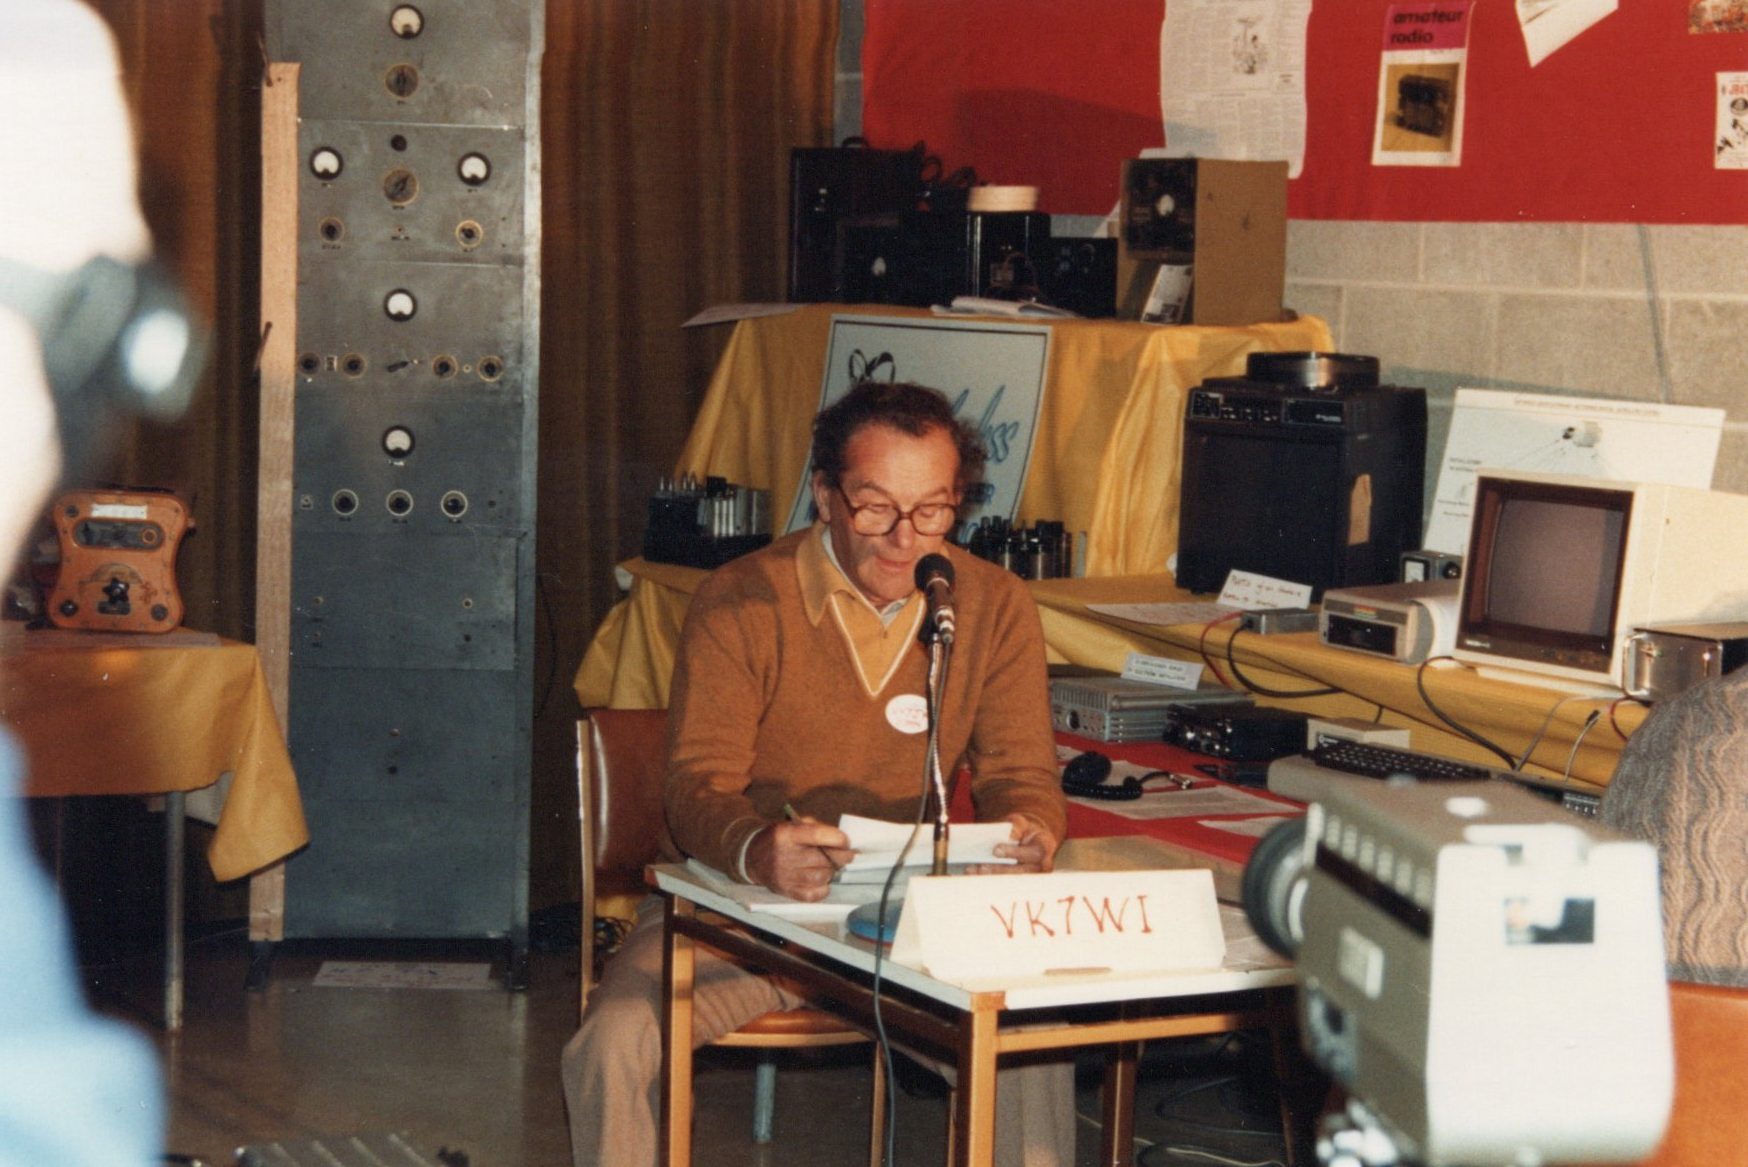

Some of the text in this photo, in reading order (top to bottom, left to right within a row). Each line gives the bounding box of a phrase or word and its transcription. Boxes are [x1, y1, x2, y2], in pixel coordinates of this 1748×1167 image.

[1394, 10, 1464, 24] amateur
[1391, 30, 1434, 43] radio
[990, 895, 1152, 938] VK7WI
